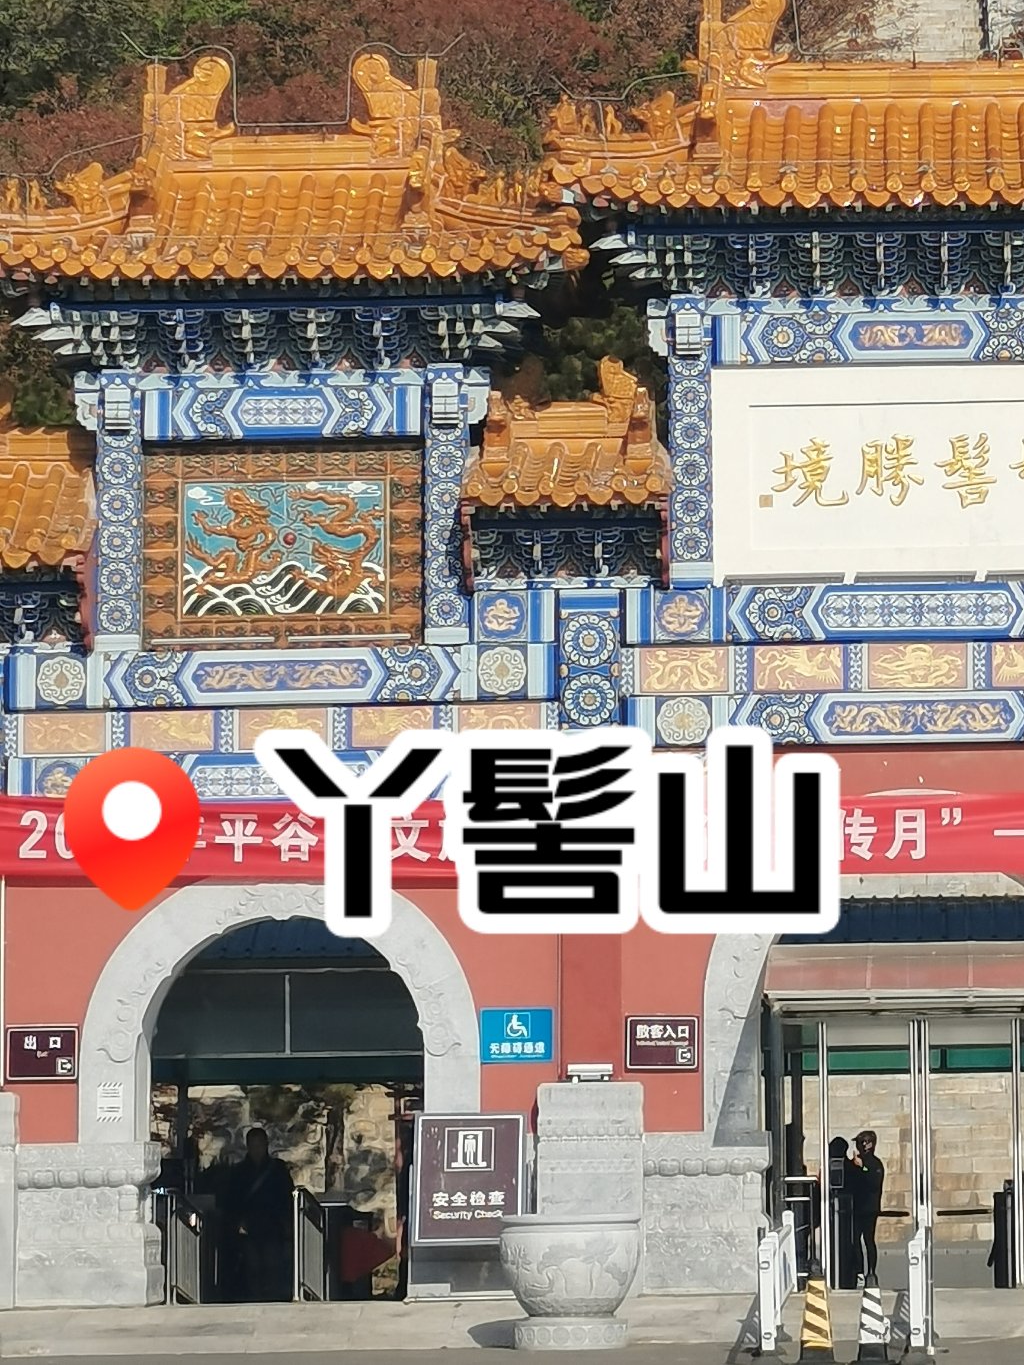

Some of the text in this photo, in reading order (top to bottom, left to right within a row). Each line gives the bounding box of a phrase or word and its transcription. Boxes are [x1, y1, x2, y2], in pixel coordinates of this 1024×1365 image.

[23, 1034, 62, 1050] 出口
[432, 1190, 506, 1207] 安全检查
[432, 1209, 504, 1221] Security Check
